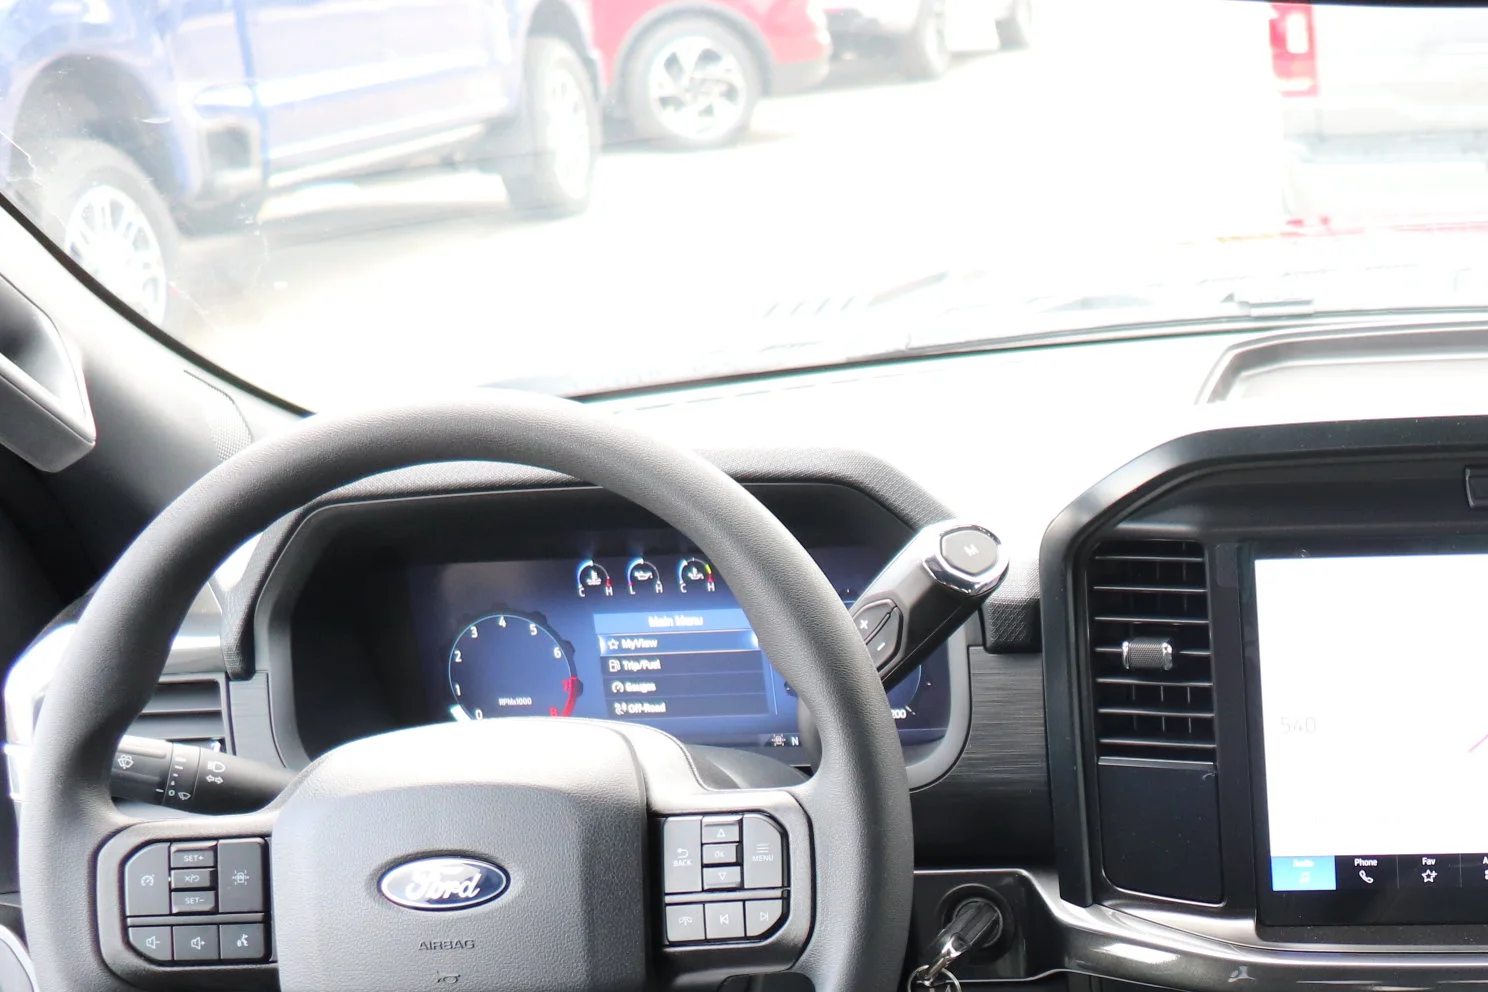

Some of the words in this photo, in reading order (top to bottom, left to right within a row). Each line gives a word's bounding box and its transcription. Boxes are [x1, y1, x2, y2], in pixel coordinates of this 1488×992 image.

[578, 587, 586, 597] C
[605, 587, 613, 596] H
[629, 585, 636, 595] L
[655, 584, 663, 593] H
[680, 583, 687, 593] C
[707, 582, 715, 592] H
[498, 616, 507, 628] 4
[470, 626, 478, 638] 3
[529, 624, 538, 636] 5
[621, 638, 658, 651] MyView
[454, 650, 462, 662] 2
[553, 647, 562, 659] 6
[622, 658, 661, 672] Trip/Fuel
[455, 683, 462, 696] 1
[625, 682, 657, 693] Gauges
[628, 702, 667, 714] Off-Road
[475, 709, 483, 720] 0
[1280, 716, 1317, 734] 540
[714, 851, 726, 859] OK
[752, 854, 774, 862] MENU
[673, 858, 692, 867] BACK
[1354, 857, 1378, 868] Phone
[1422, 857, 1436, 866] Fav
[405, 866, 482, 900] Ford
[419, 940, 475, 951] AIRBAG
